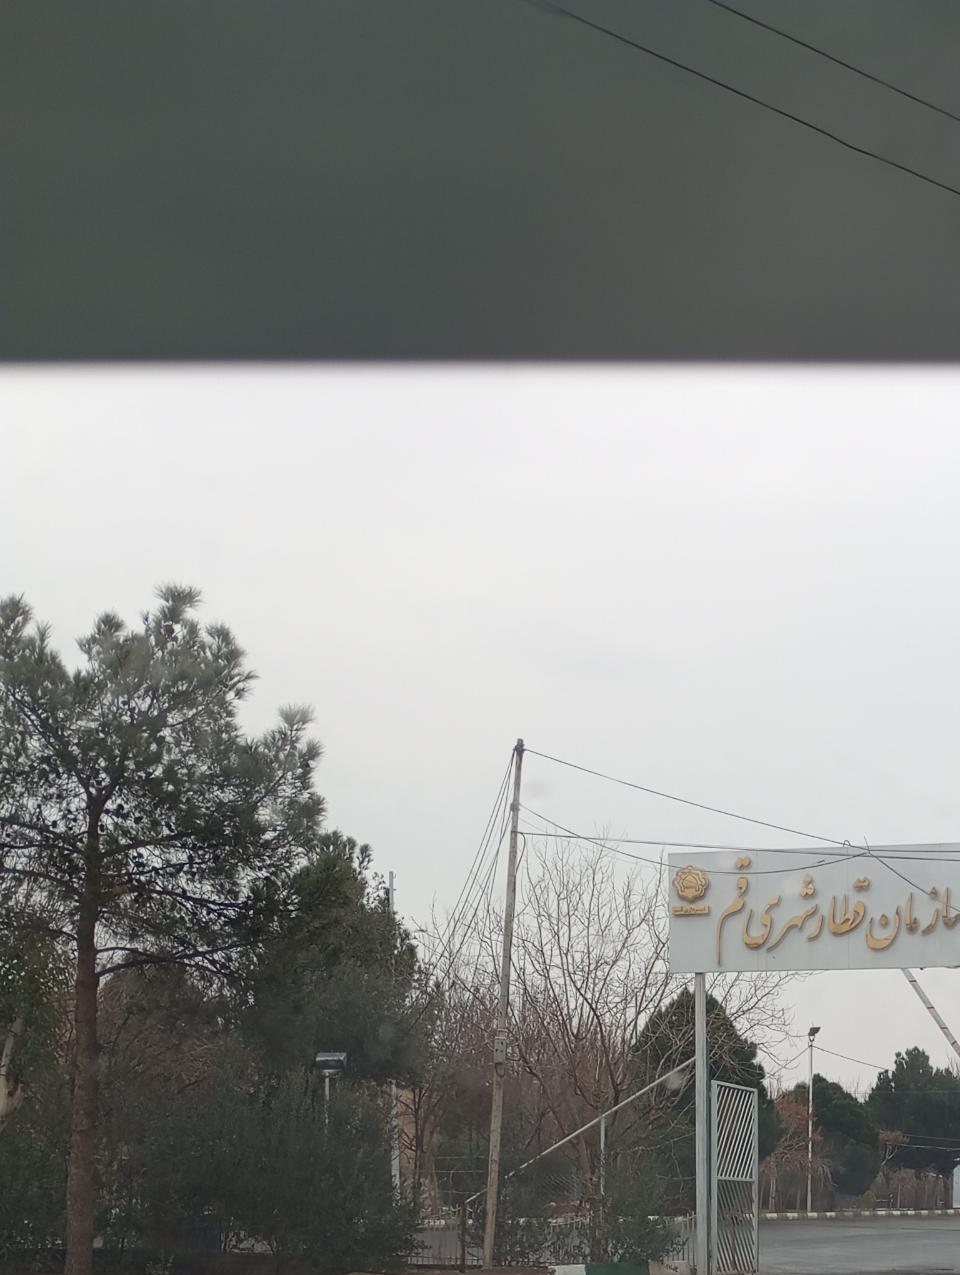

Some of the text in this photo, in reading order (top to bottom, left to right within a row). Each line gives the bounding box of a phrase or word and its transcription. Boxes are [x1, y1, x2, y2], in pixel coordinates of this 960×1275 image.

[716, 855, 751, 966] قم
[743, 873, 817, 951] شهری
[807, 877, 871, 943] قطار
